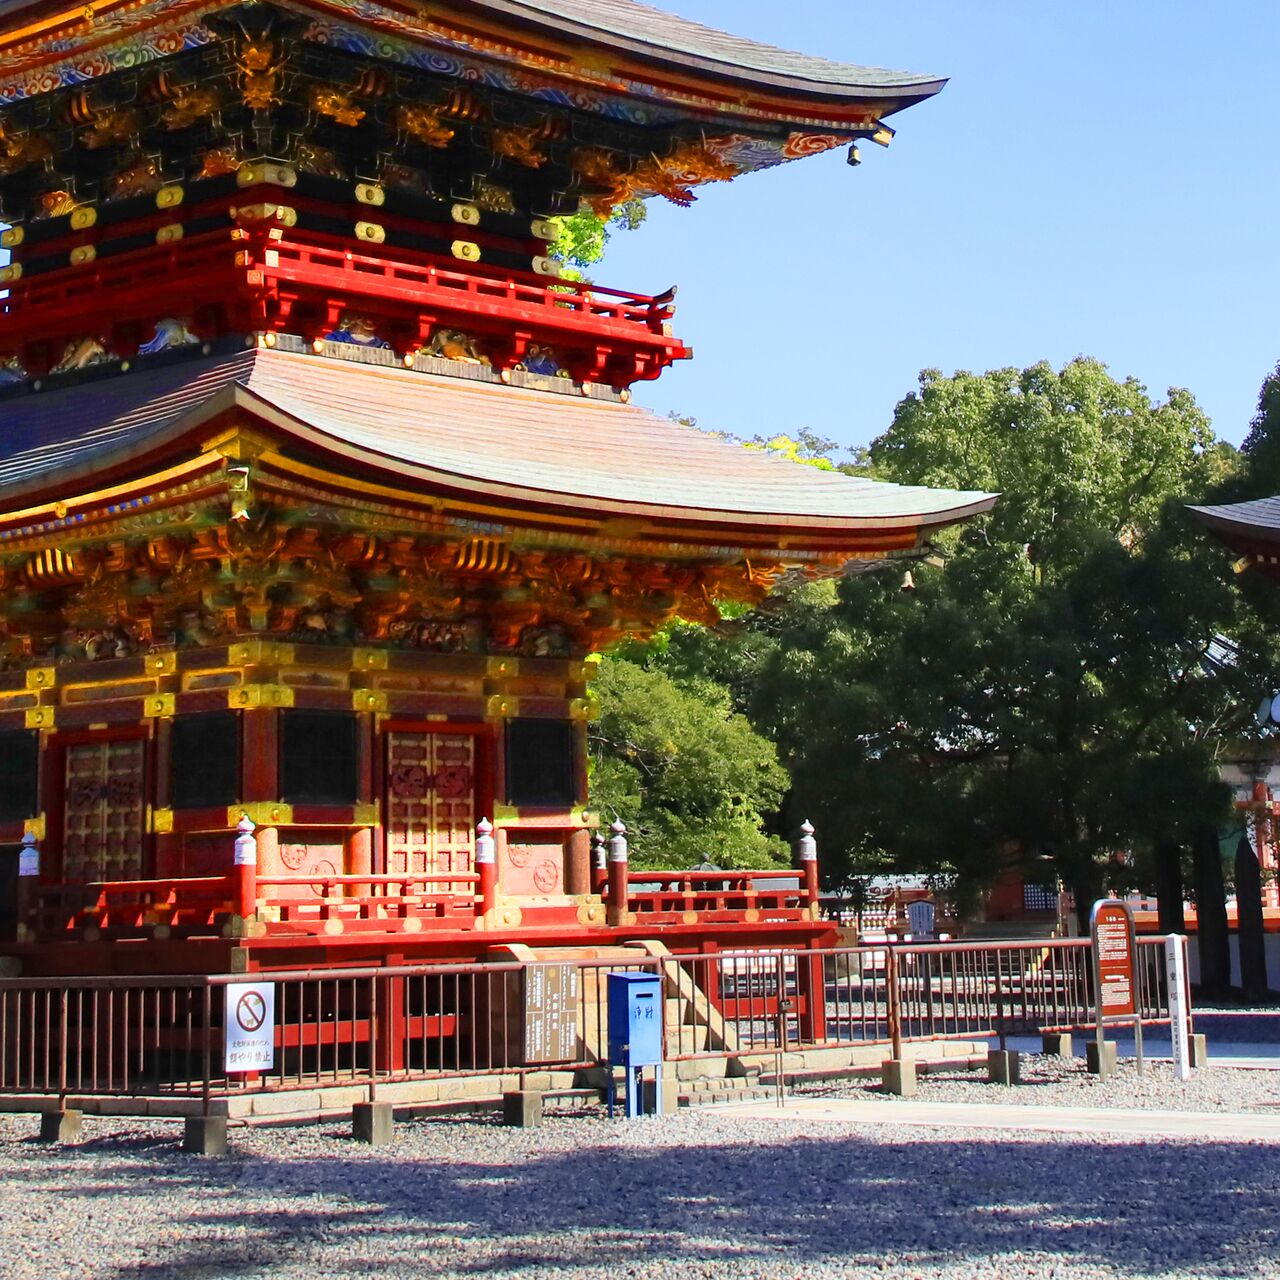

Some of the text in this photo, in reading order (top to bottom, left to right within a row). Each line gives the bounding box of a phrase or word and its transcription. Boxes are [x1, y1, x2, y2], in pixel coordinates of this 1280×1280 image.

[230, 1050, 271, 1064] 餌やり禁止
